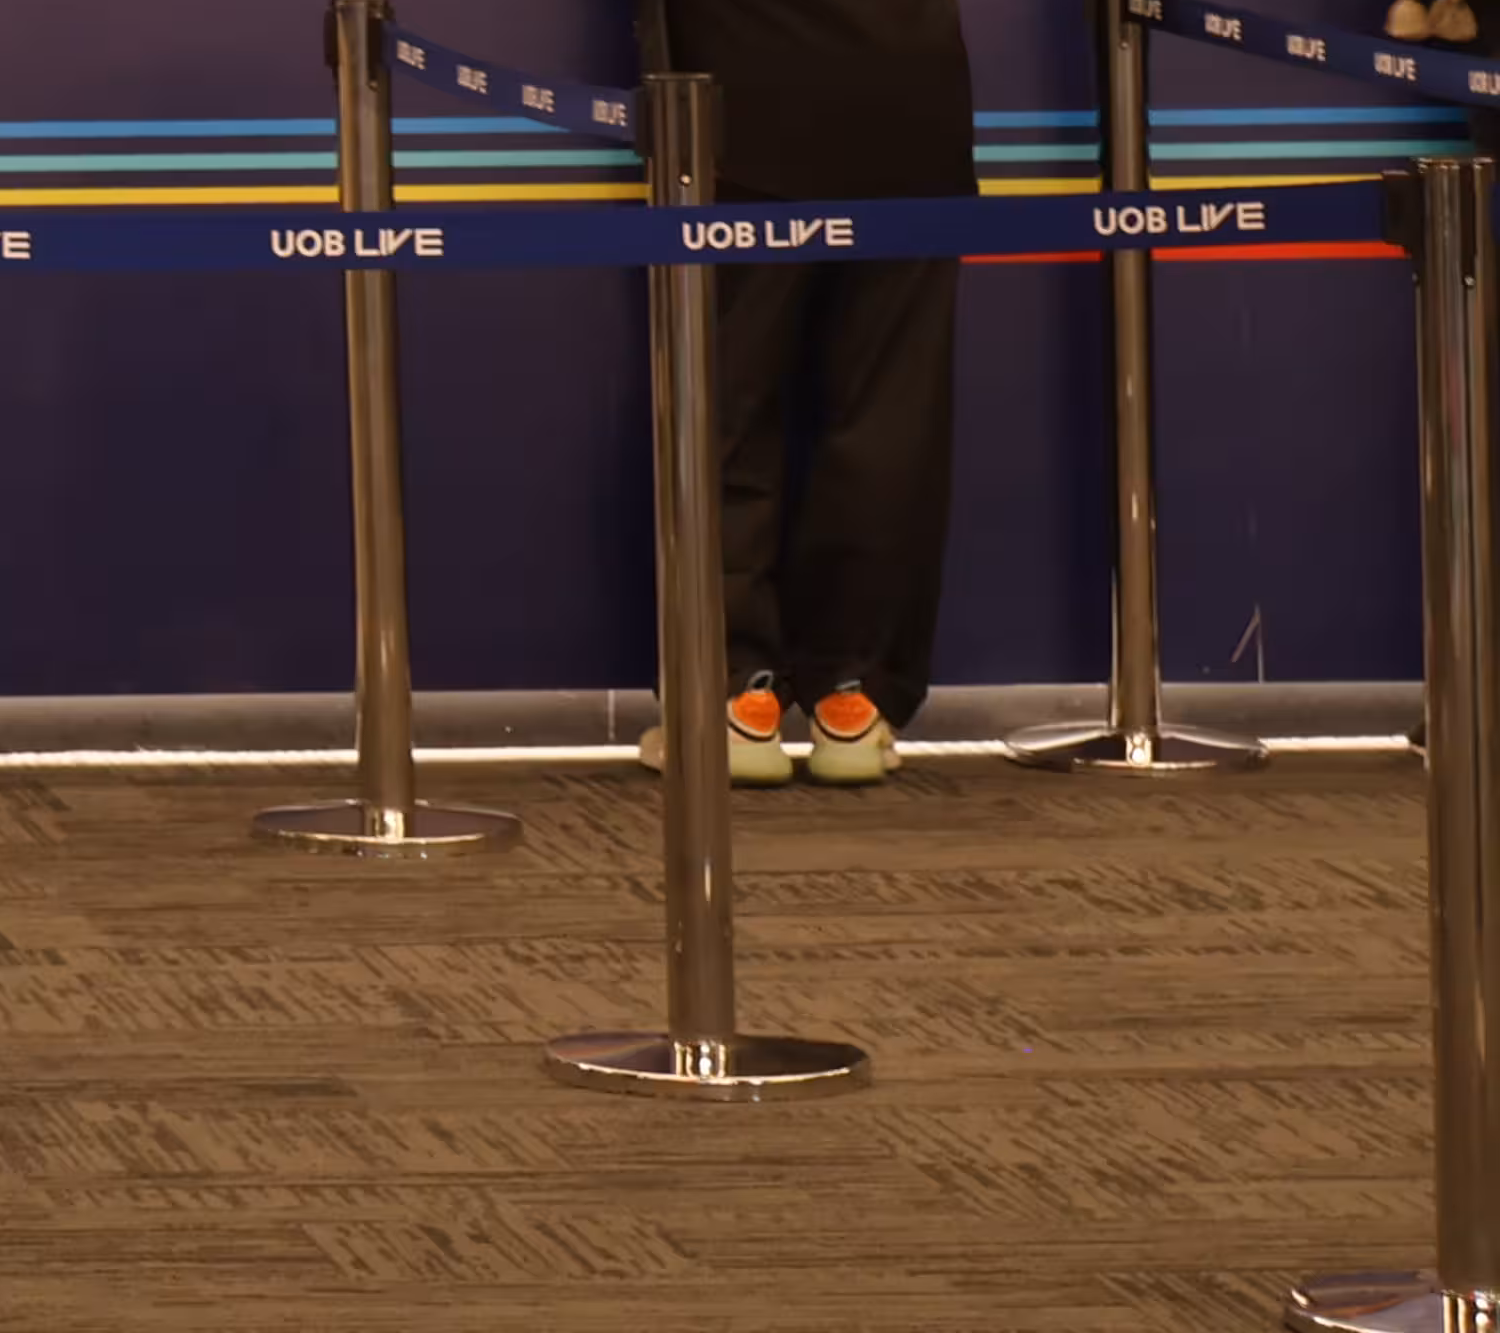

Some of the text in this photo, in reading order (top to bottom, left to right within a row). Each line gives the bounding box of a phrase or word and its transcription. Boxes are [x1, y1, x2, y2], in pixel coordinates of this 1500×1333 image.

[682, 218, 854, 250] UOB LIVE
[1093, 202, 1265, 235] UOB LIVE
[270, 228, 443, 257] UOB LIVE
